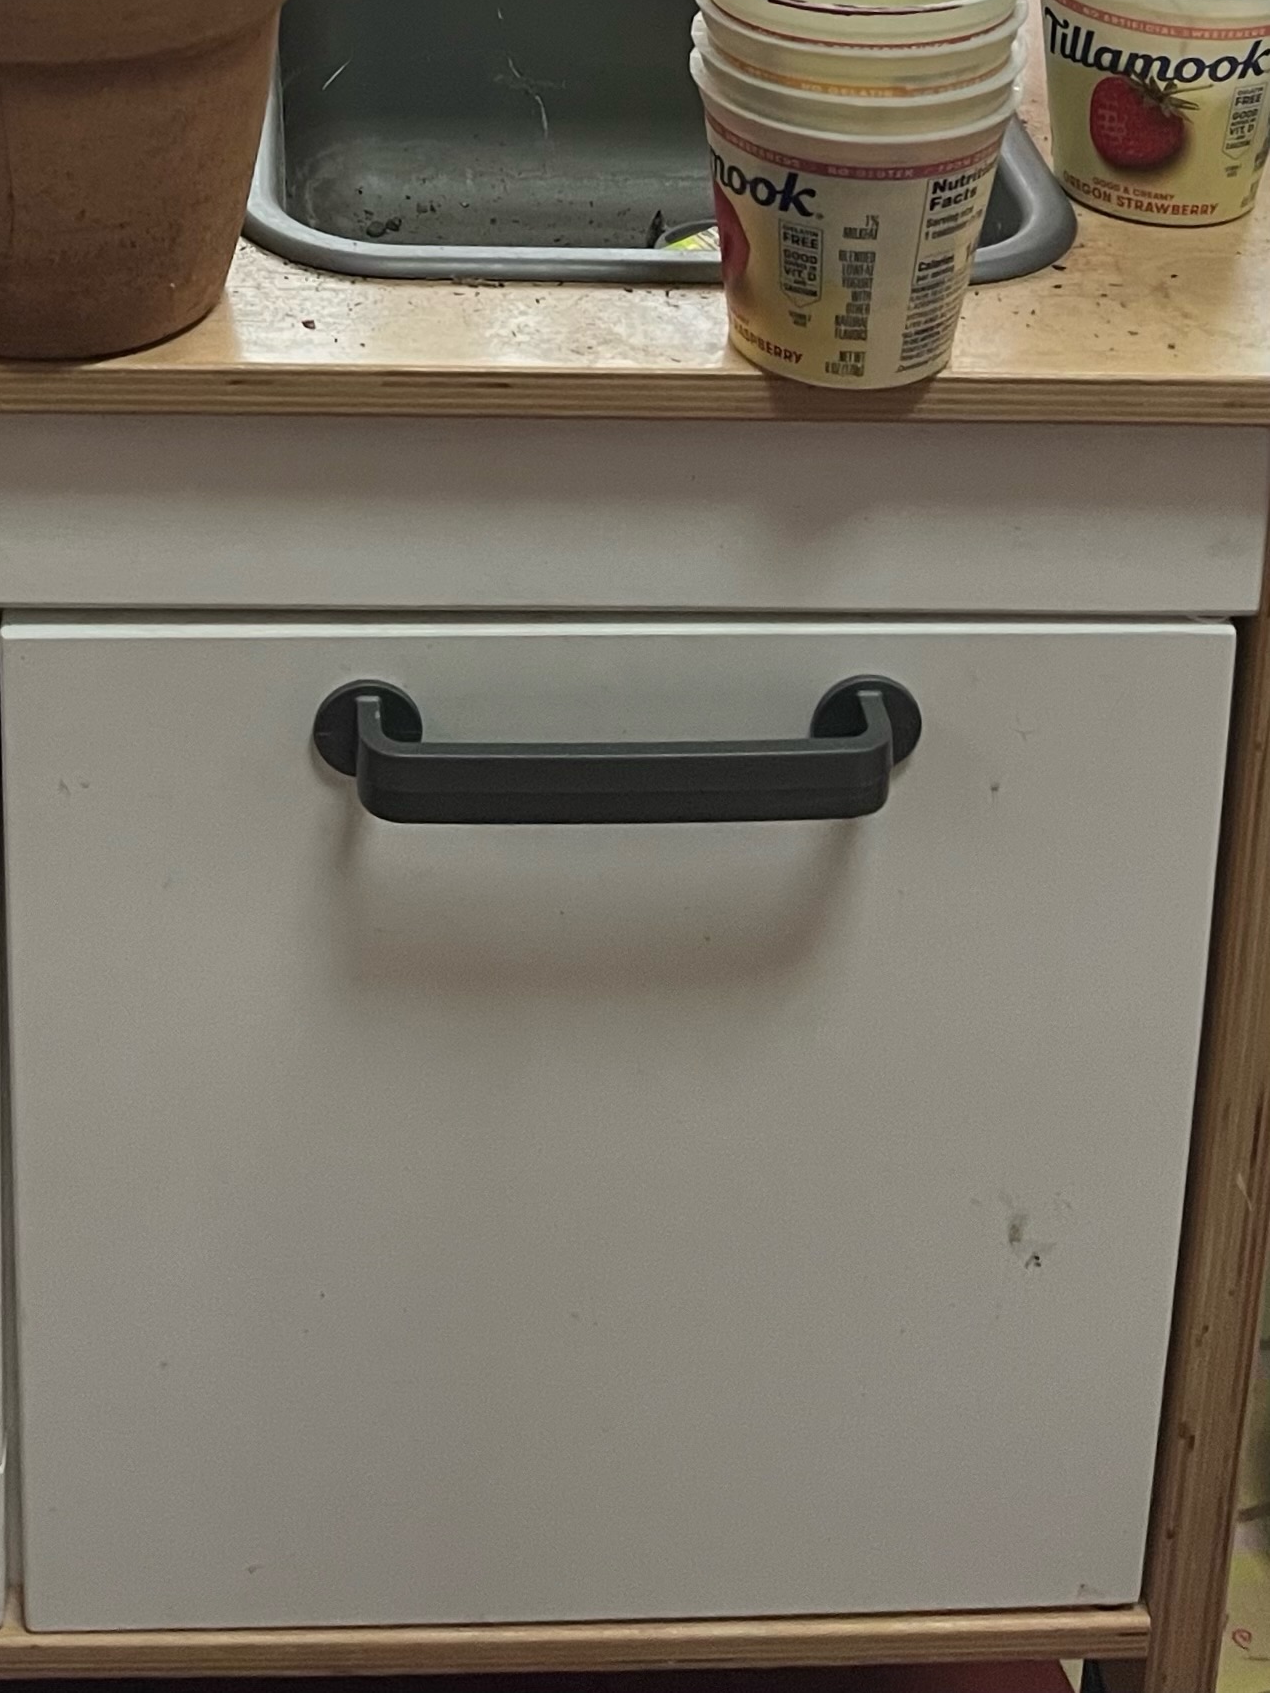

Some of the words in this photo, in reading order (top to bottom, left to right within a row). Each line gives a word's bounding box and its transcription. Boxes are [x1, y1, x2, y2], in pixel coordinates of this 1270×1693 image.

[1044, 5, 1270, 83] Tillamook
[1234, 93, 1262, 106] FREE
[929, 185, 978, 211] Facts
[1063, 170, 1113, 204] OREGON
[1116, 195, 1219, 216] STRAWBERRY
[1134, 188, 1175, 202] CREAMY
[783, 231, 819, 249] FREE
[783, 249, 818, 264] GOOD
